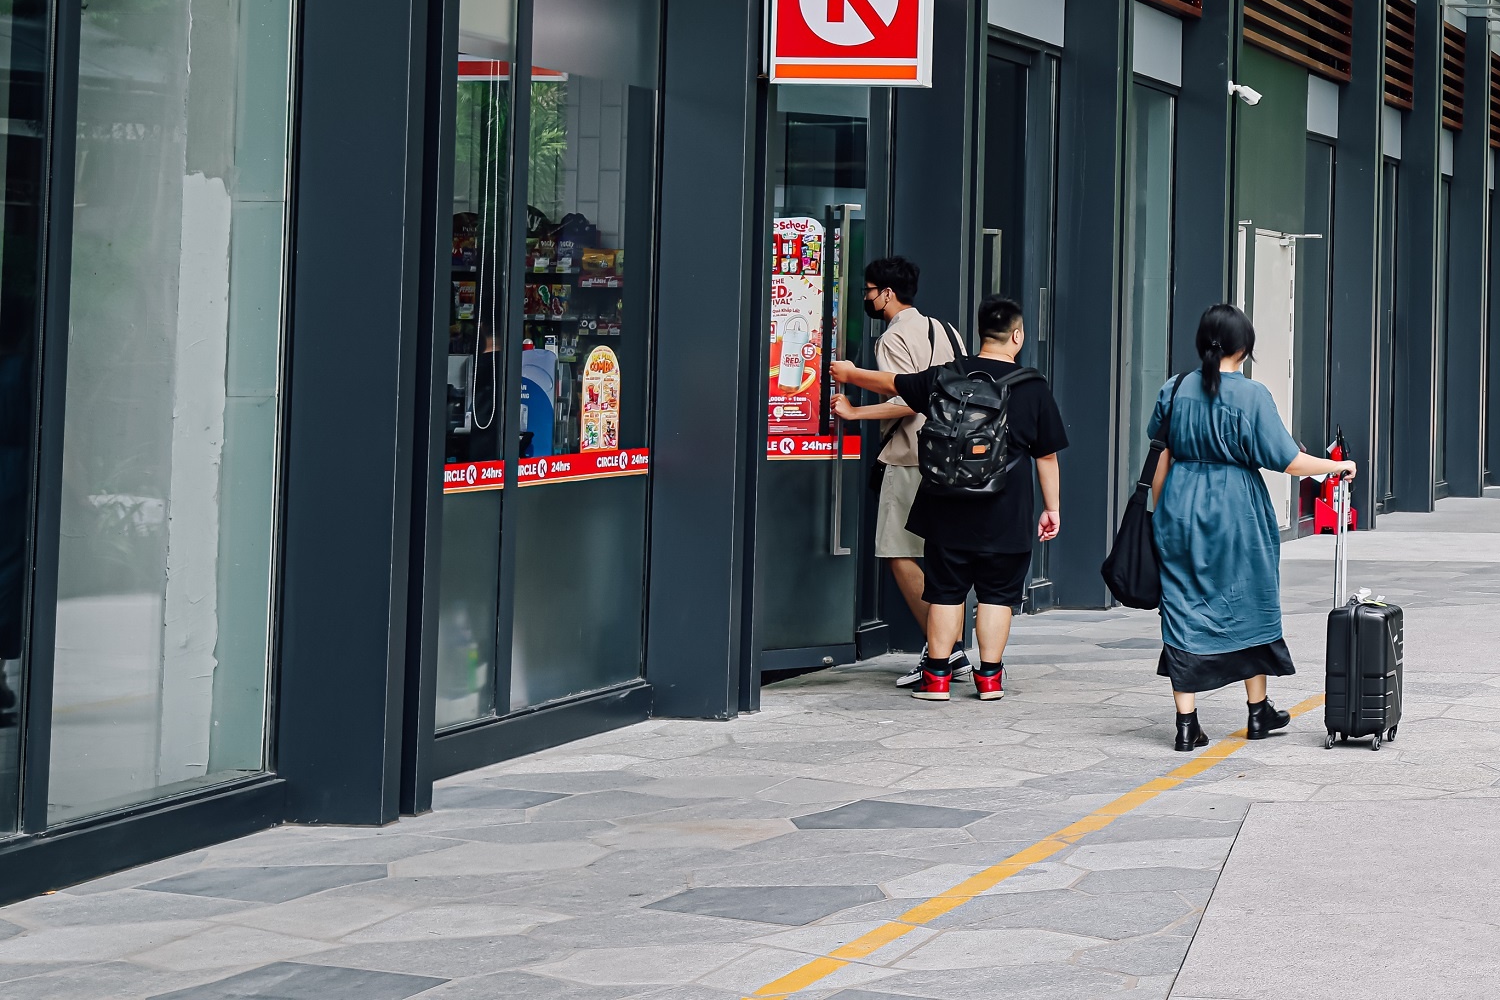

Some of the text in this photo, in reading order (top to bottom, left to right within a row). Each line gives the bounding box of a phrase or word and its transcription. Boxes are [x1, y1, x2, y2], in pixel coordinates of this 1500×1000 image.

[779, 219, 809, 232] School
[771, 285, 788, 299] ED
[781, 439, 794, 453] K
[801, 440, 832, 451] 24hrs
[518, 452, 649, 477] IRCLE K 24hrs CIRCLE K 24hrs
[444, 465, 502, 484] IRCLE K 24hrs
